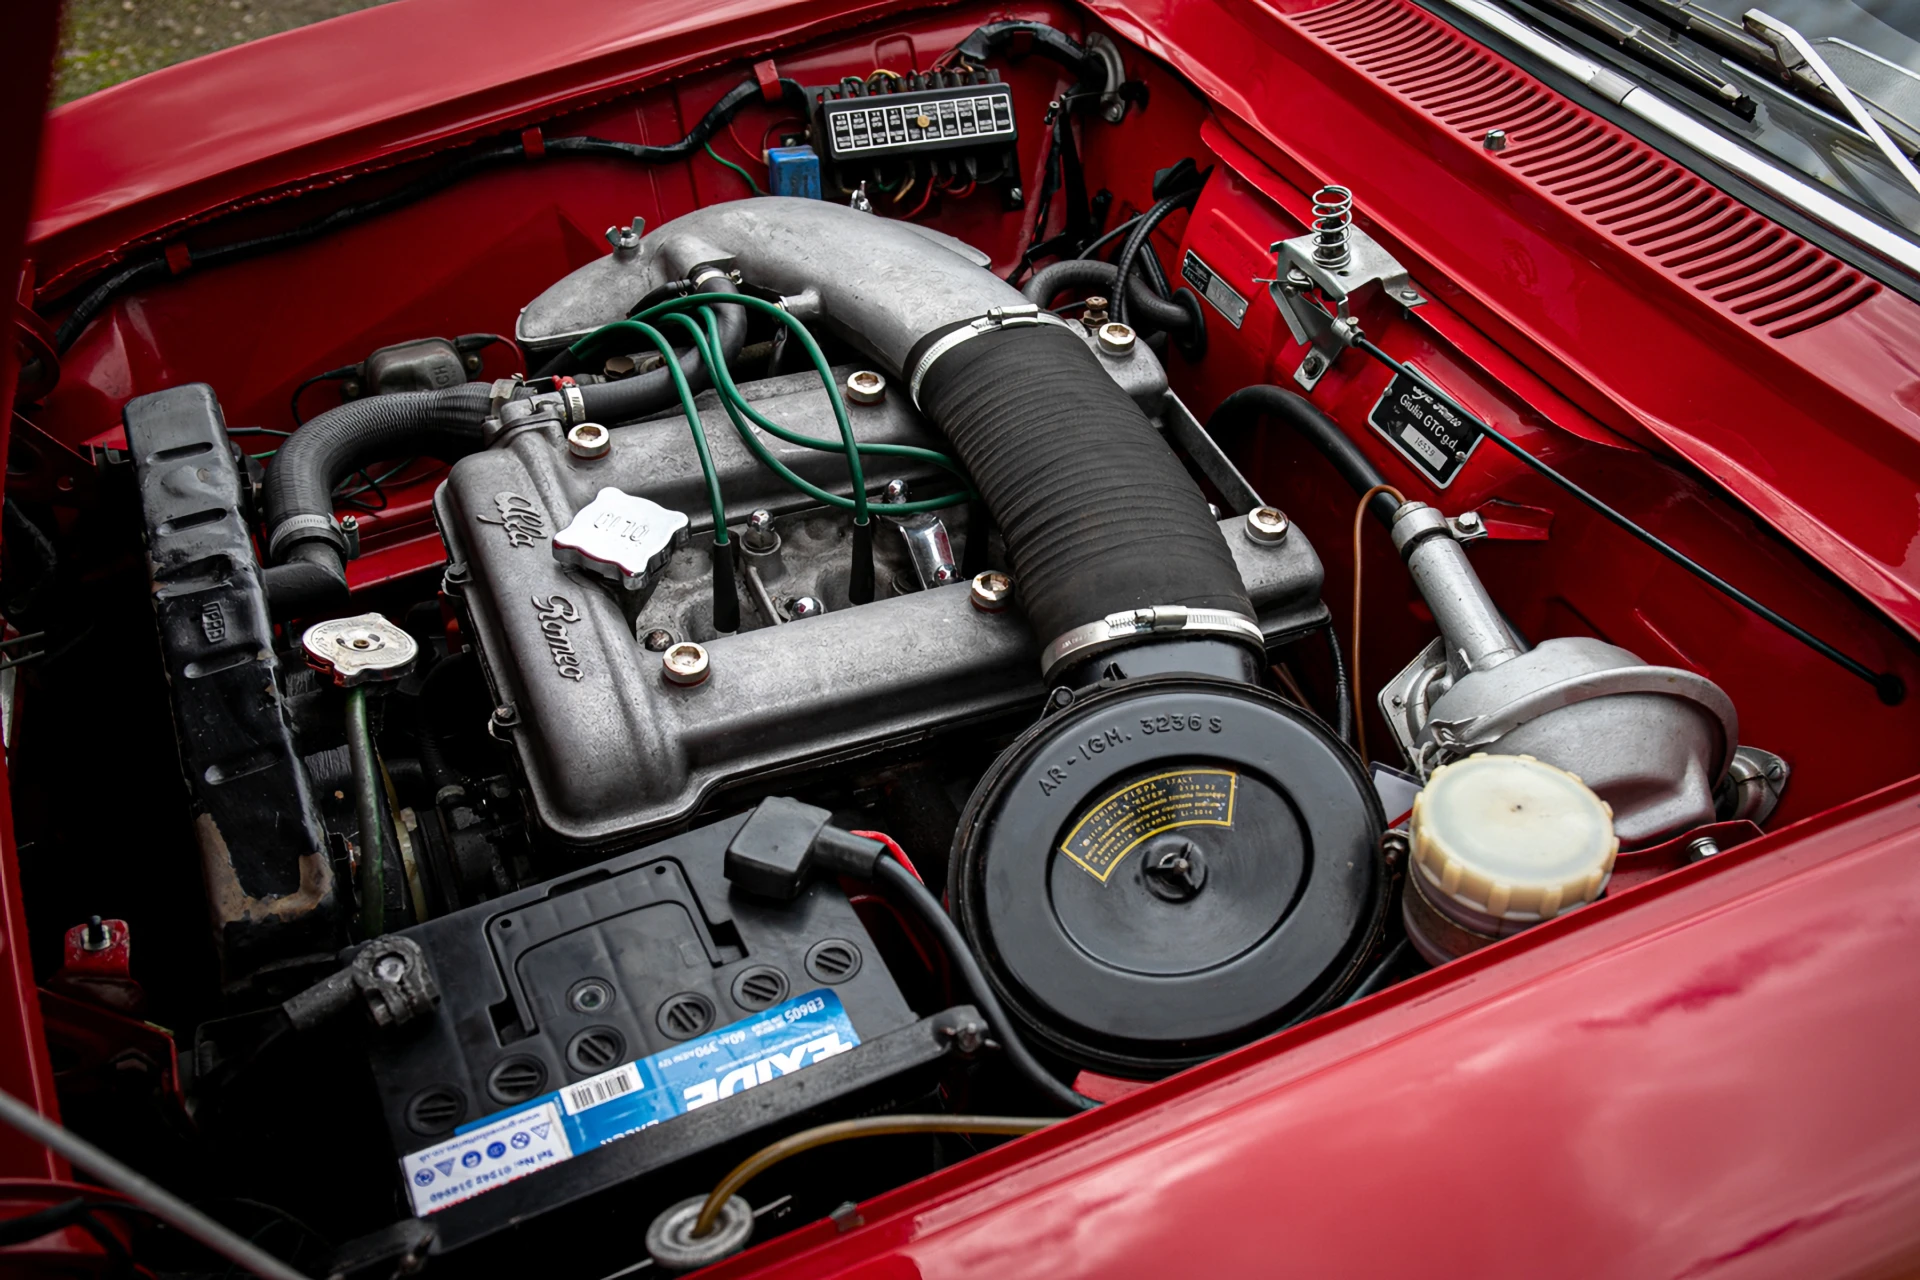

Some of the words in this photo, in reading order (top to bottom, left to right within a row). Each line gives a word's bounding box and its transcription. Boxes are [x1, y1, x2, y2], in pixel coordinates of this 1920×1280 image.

[1399, 393, 1423, 419] Giulia
[1423, 414, 1445, 437] GTC
[477, 491, 547, 548] Alfa
[531, 594, 584, 682] Romeo
[1140, 714, 1202, 736] 3236
[1208, 717, 1223, 734] S
[1089, 800, 1118, 825] TORINO
[1122, 782, 1156, 801] FISPA
[782, 995, 826, 1023] EB605
[683, 1034, 853, 1111] EXIDE
[536, 1148, 554, 1161] Tel
